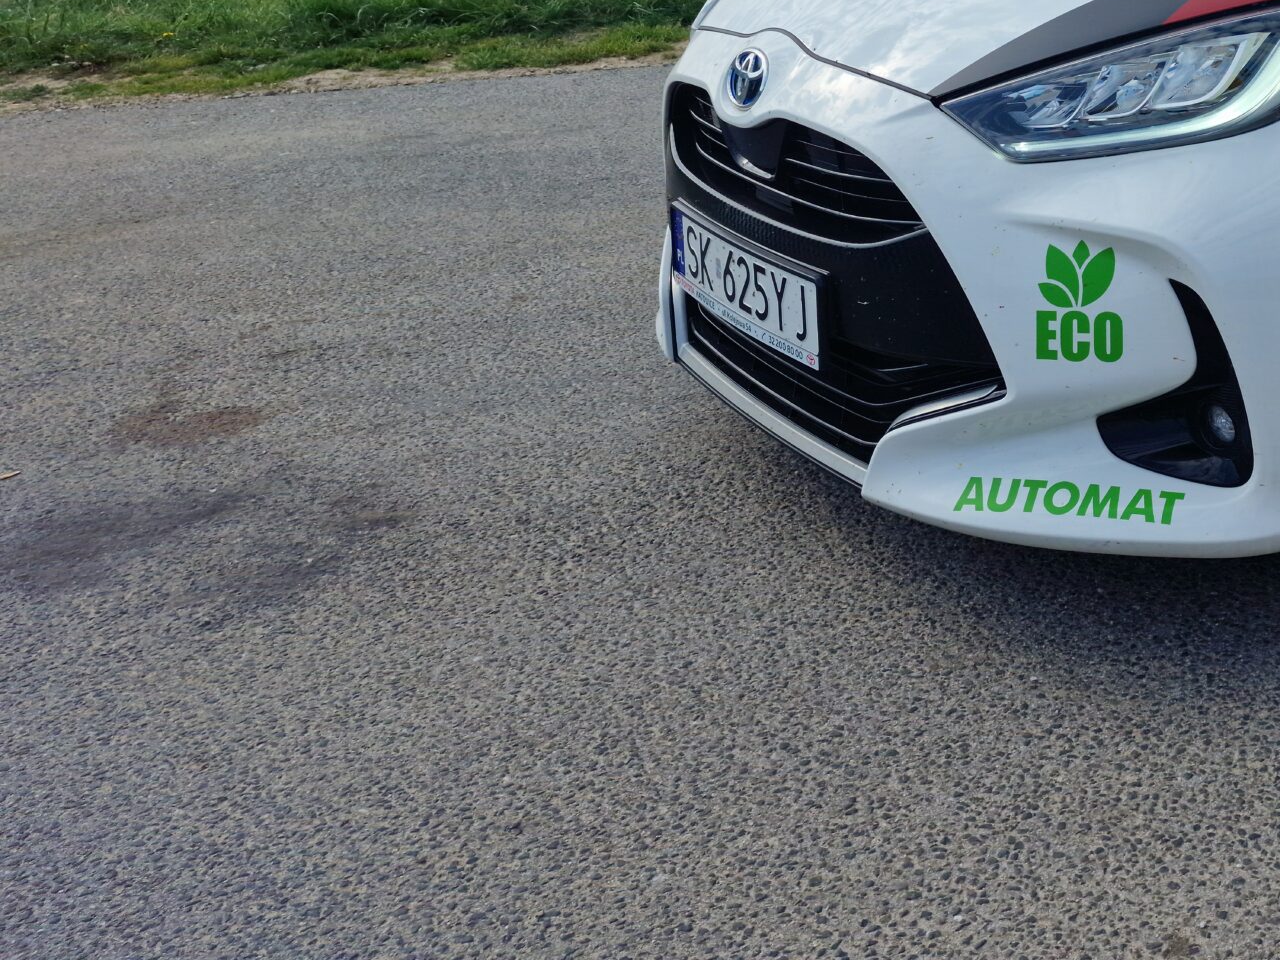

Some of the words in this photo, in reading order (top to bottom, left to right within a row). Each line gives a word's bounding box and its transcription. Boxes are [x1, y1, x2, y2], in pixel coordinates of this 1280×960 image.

[686, 225, 713, 291] SK
[723, 250, 807, 341] 625YJ
[1036, 310, 1123, 363] ECO
[953, 476, 1185, 525] AUTOMAT
